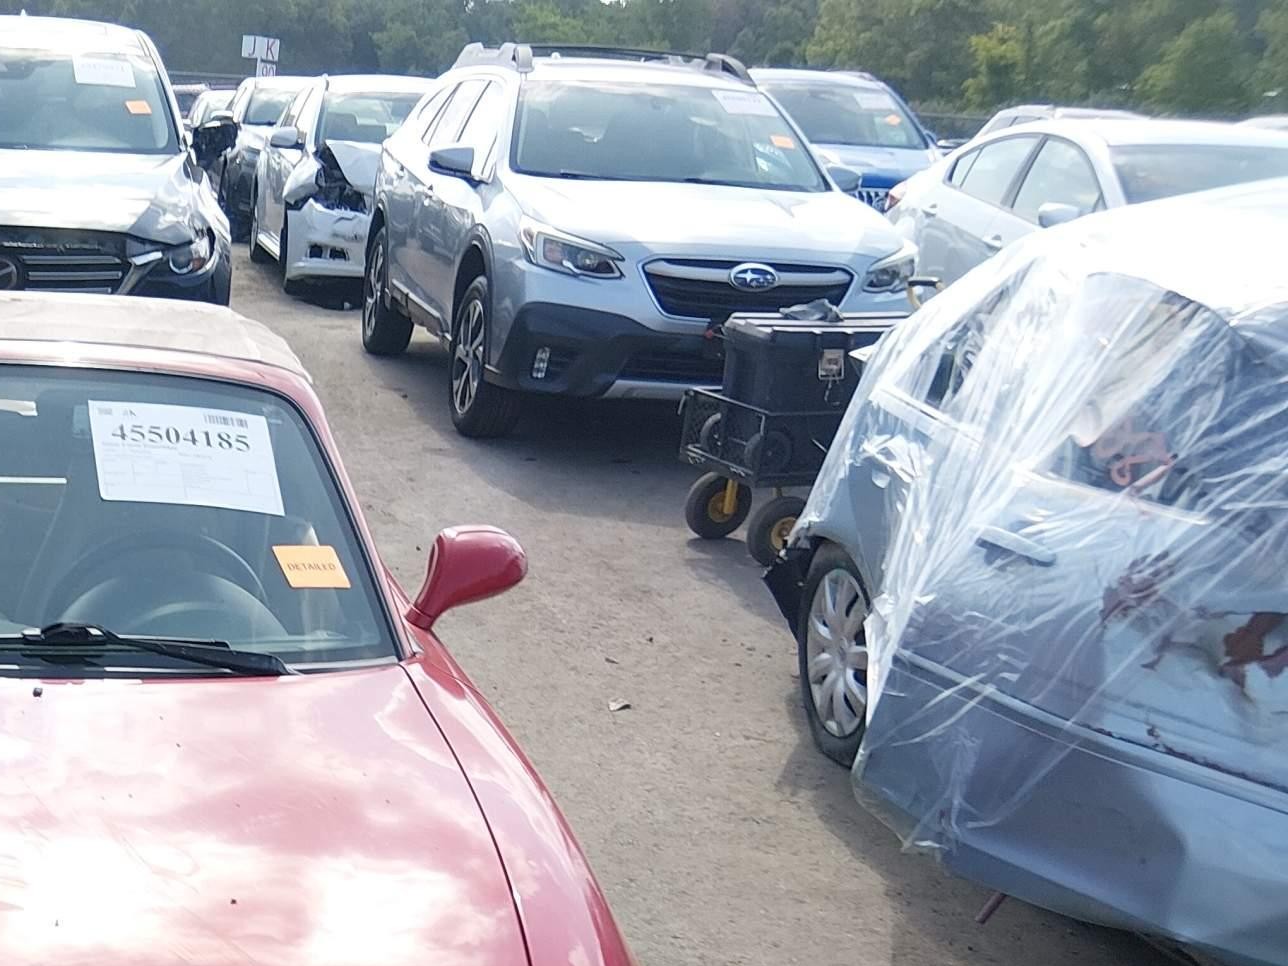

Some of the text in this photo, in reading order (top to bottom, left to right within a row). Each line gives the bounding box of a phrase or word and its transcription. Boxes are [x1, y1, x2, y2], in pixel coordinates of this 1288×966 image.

[248, 36, 276, 60] J K
[112, 424, 250, 452] 45504185
[287, 562, 337, 571] DETAILED
